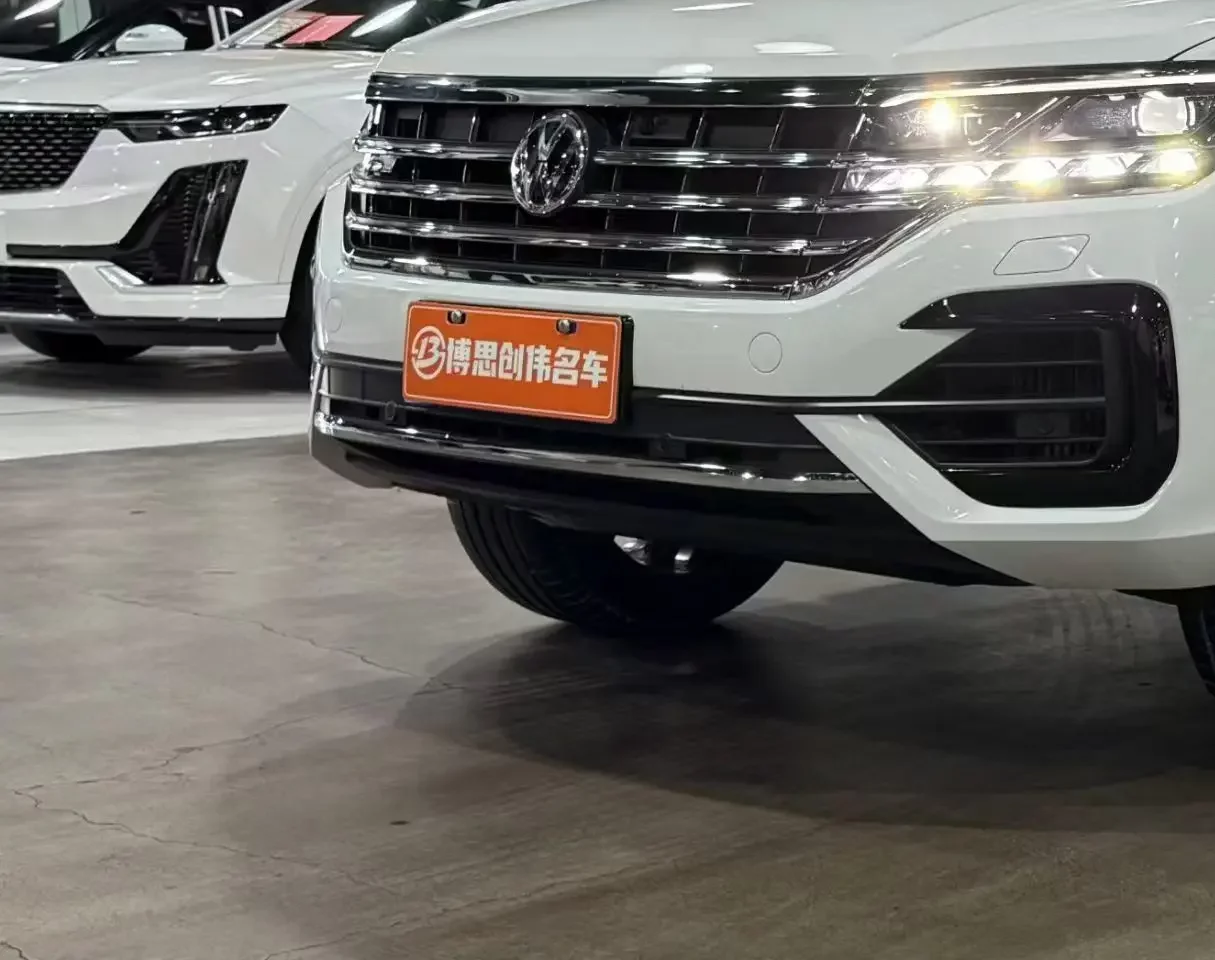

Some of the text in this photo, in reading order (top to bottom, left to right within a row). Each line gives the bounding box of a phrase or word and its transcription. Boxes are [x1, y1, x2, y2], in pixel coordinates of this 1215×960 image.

[445, 337, 609, 388] 博思创伟名车
